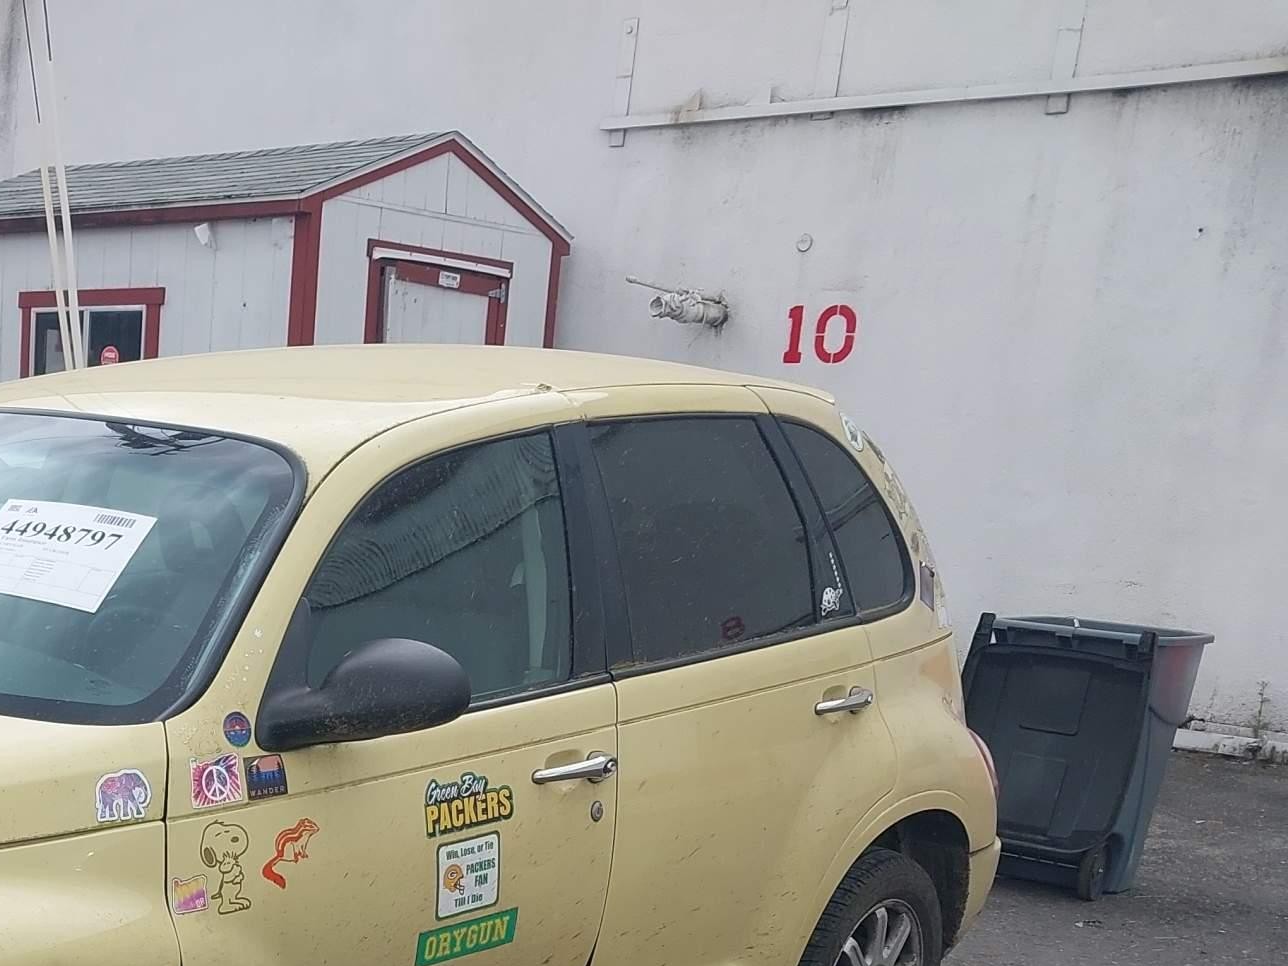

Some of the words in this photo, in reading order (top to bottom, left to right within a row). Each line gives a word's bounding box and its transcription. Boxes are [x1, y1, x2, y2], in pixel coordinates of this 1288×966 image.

[783, 304, 857, 364] 10
[1, 519, 124, 550] 44948797
[250, 785, 285, 797] WANDER
[427, 782, 458, 805] Green
[460, 774, 486, 800] Bay
[426, 789, 512, 833] PACKERS
[466, 857, 496, 876] PACKERS
[474, 873, 489, 887] FAN
[423, 916, 511, 961] ORYGUN
